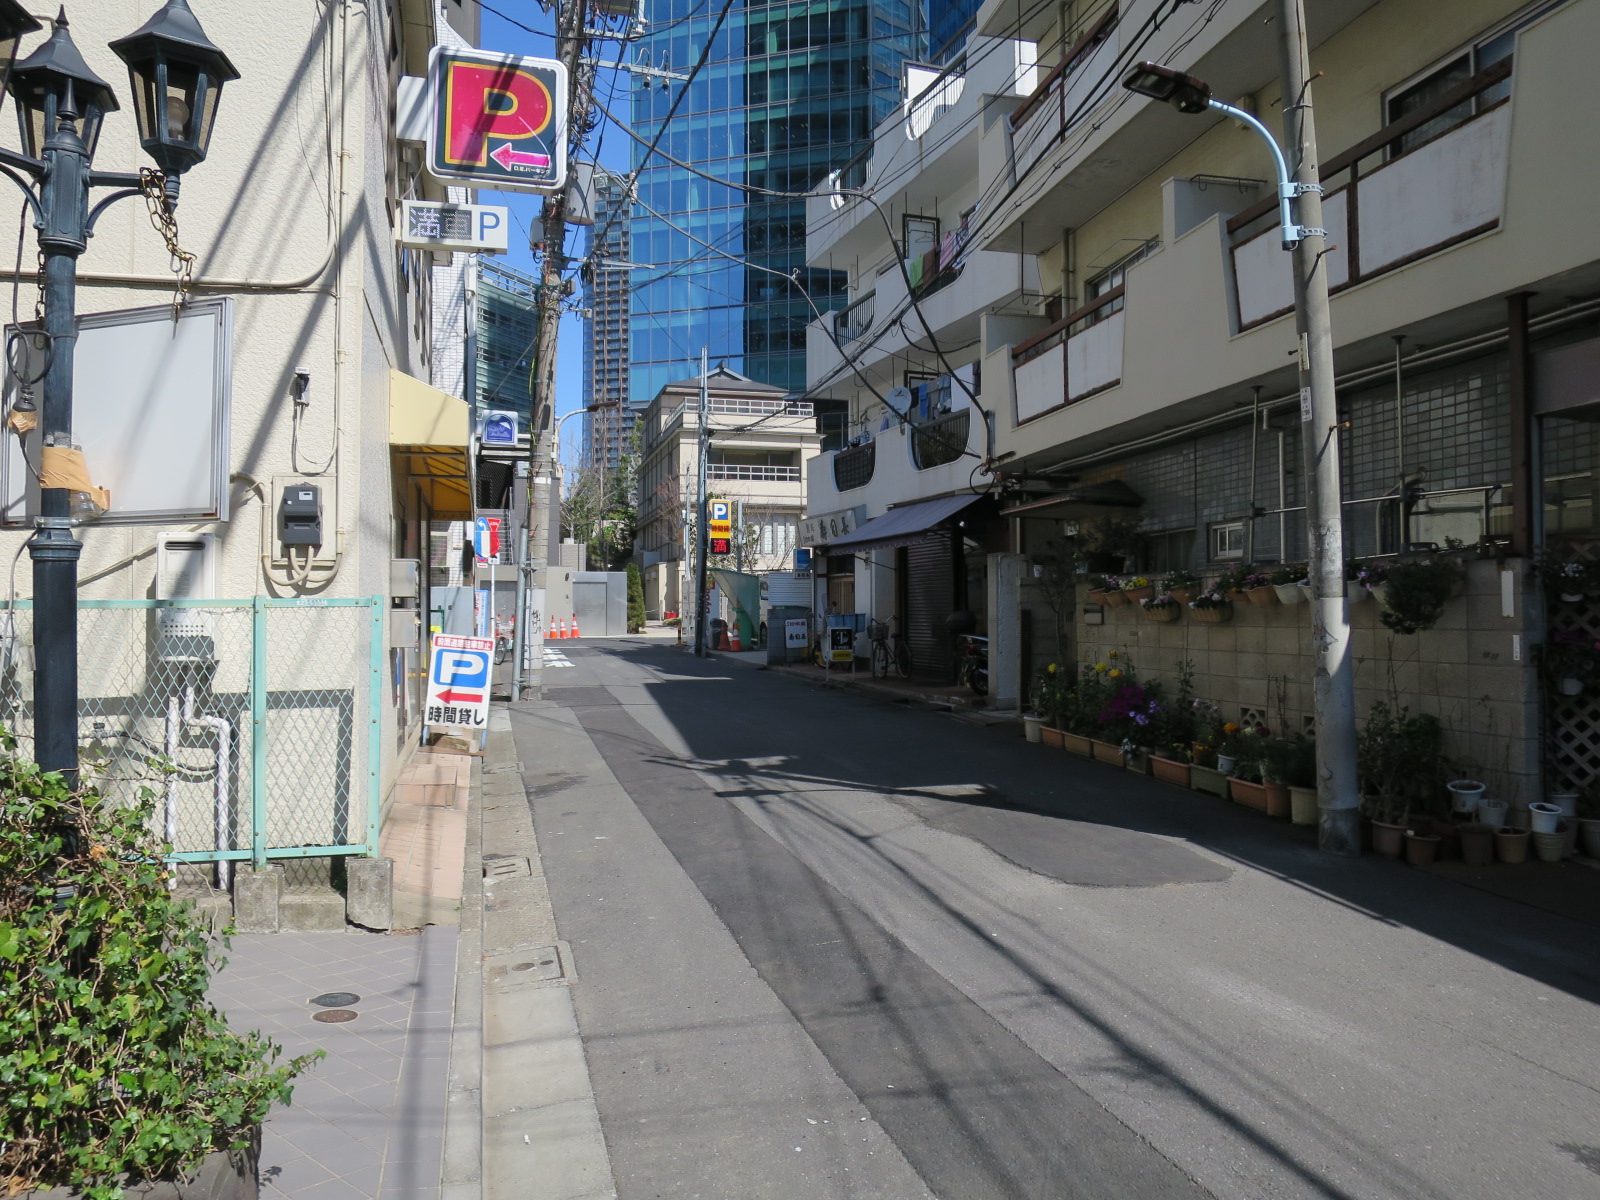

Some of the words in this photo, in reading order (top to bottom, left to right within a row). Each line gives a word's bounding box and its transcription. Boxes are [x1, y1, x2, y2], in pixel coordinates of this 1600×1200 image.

[445, 61, 552, 167] P
[410, 208, 472, 240] 満車
[480, 212, 500, 241] P
[714, 504, 726, 519] P
[713, 540, 727, 553] 満
[440, 652, 484, 683] P
[428, 706, 484, 726] 時間貸し
